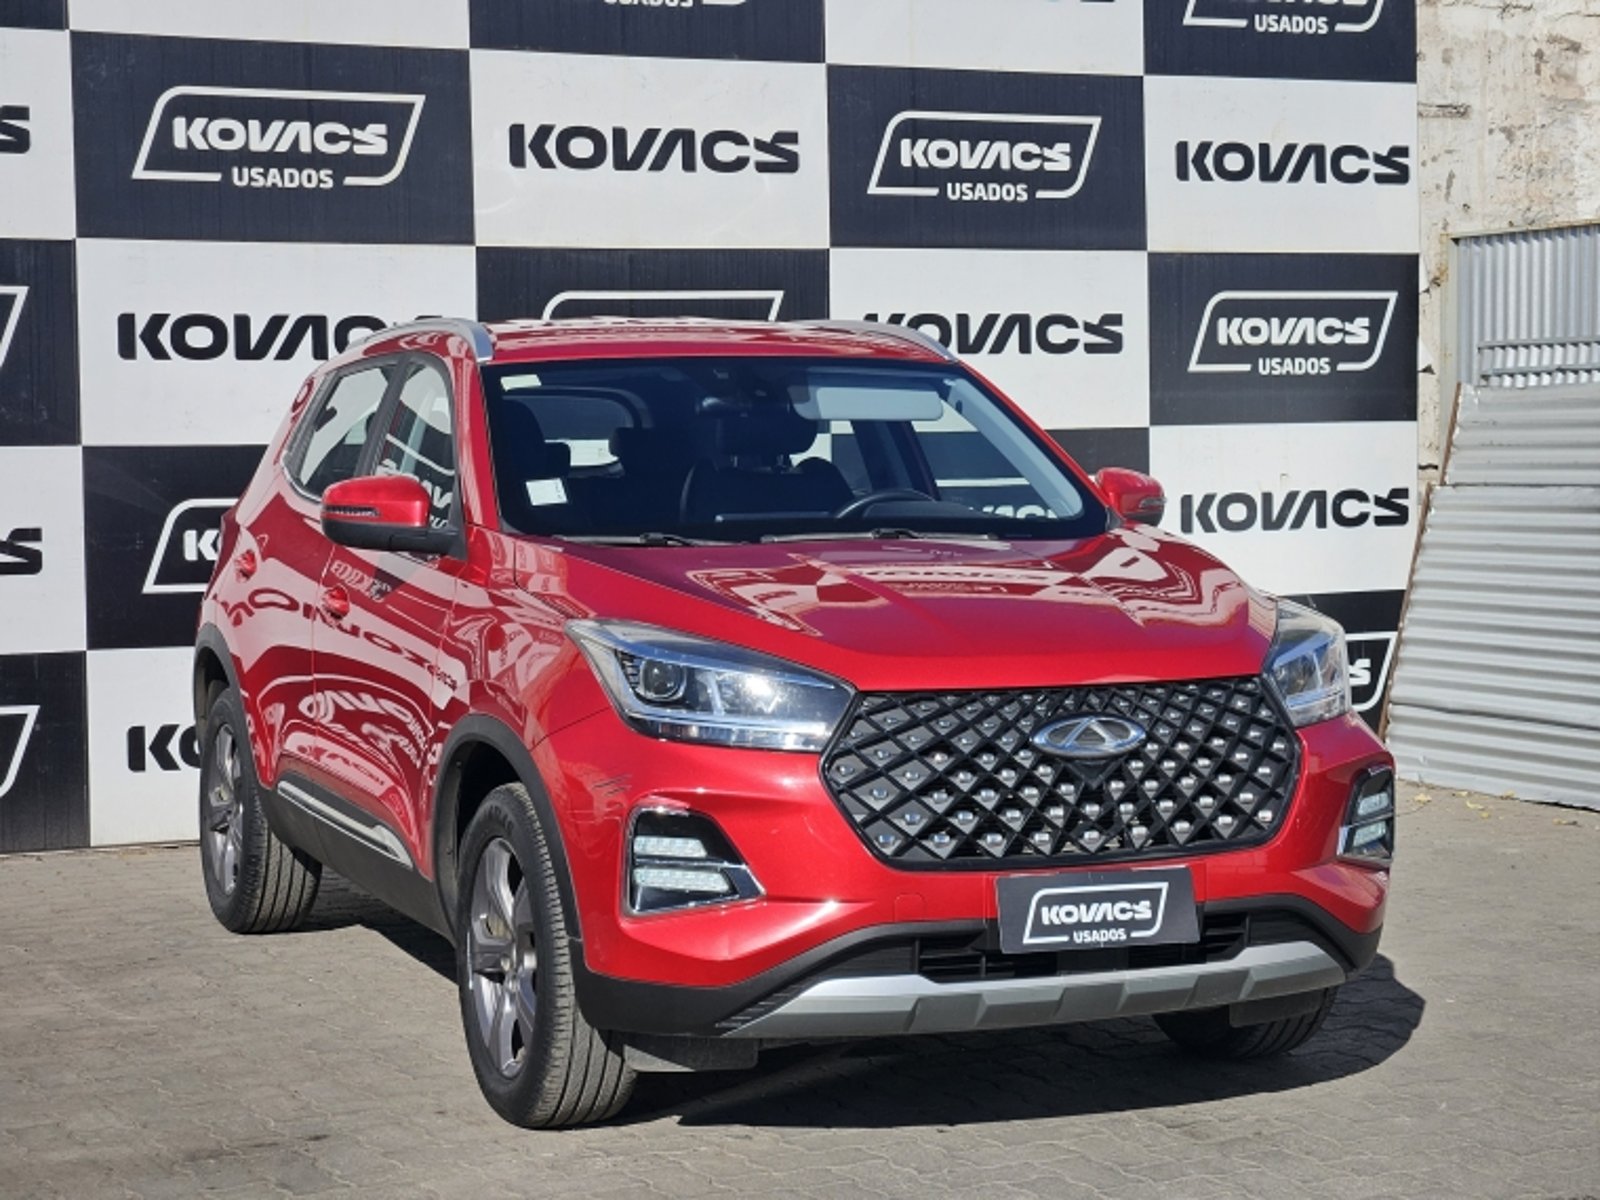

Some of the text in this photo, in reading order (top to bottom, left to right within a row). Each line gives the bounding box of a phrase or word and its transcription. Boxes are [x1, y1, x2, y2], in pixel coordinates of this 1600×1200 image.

[1254, 14, 1329, 34] USADOS
[172, 117, 388, 155] KOVACS
[508, 123, 800, 174] KOVACS
[900, 138, 1071, 171] KOVACS
[1175, 140, 1410, 184] KOVACS
[231, 167, 334, 189] USADOS
[946, 182, 1028, 202] USADOS
[863, 313, 1123, 354] OVACS
[1217, 317, 1370, 345] KOVACS
[1258, 357, 1331, 376] USADOS
[1180, 488, 1410, 534] KOVACS
[1041, 900, 1153, 926] KOVACS
[1073, 928, 1127, 944] USADOS
